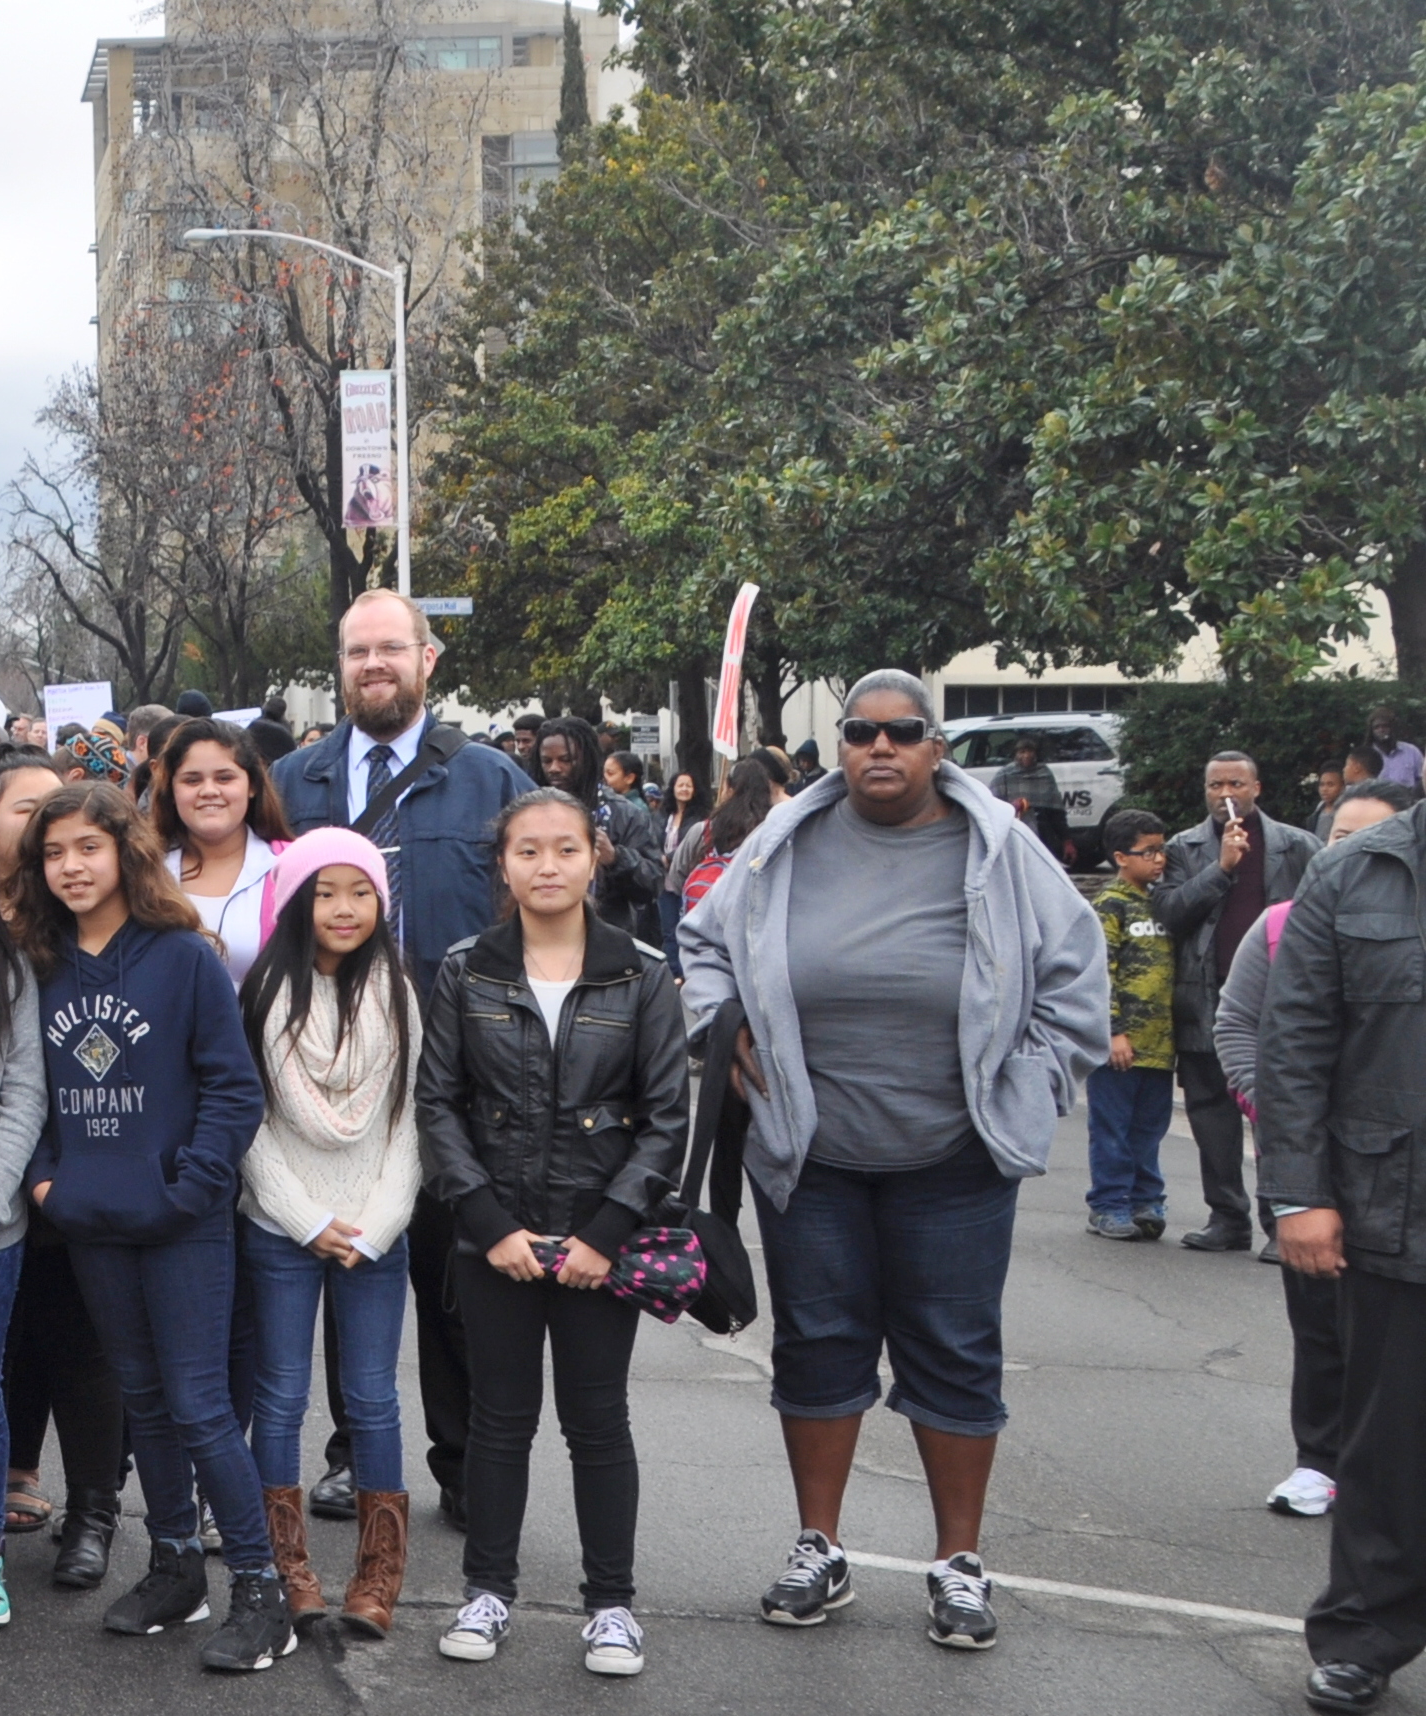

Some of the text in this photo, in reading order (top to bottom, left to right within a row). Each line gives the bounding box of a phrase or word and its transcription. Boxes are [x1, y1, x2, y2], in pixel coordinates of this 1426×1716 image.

[342, 401, 388, 434] ROAR
[47, 994, 151, 1048] HOLLISTER
[58, 1085, 145, 1115] COMPANY
[85, 1117, 120, 1138] 1922
